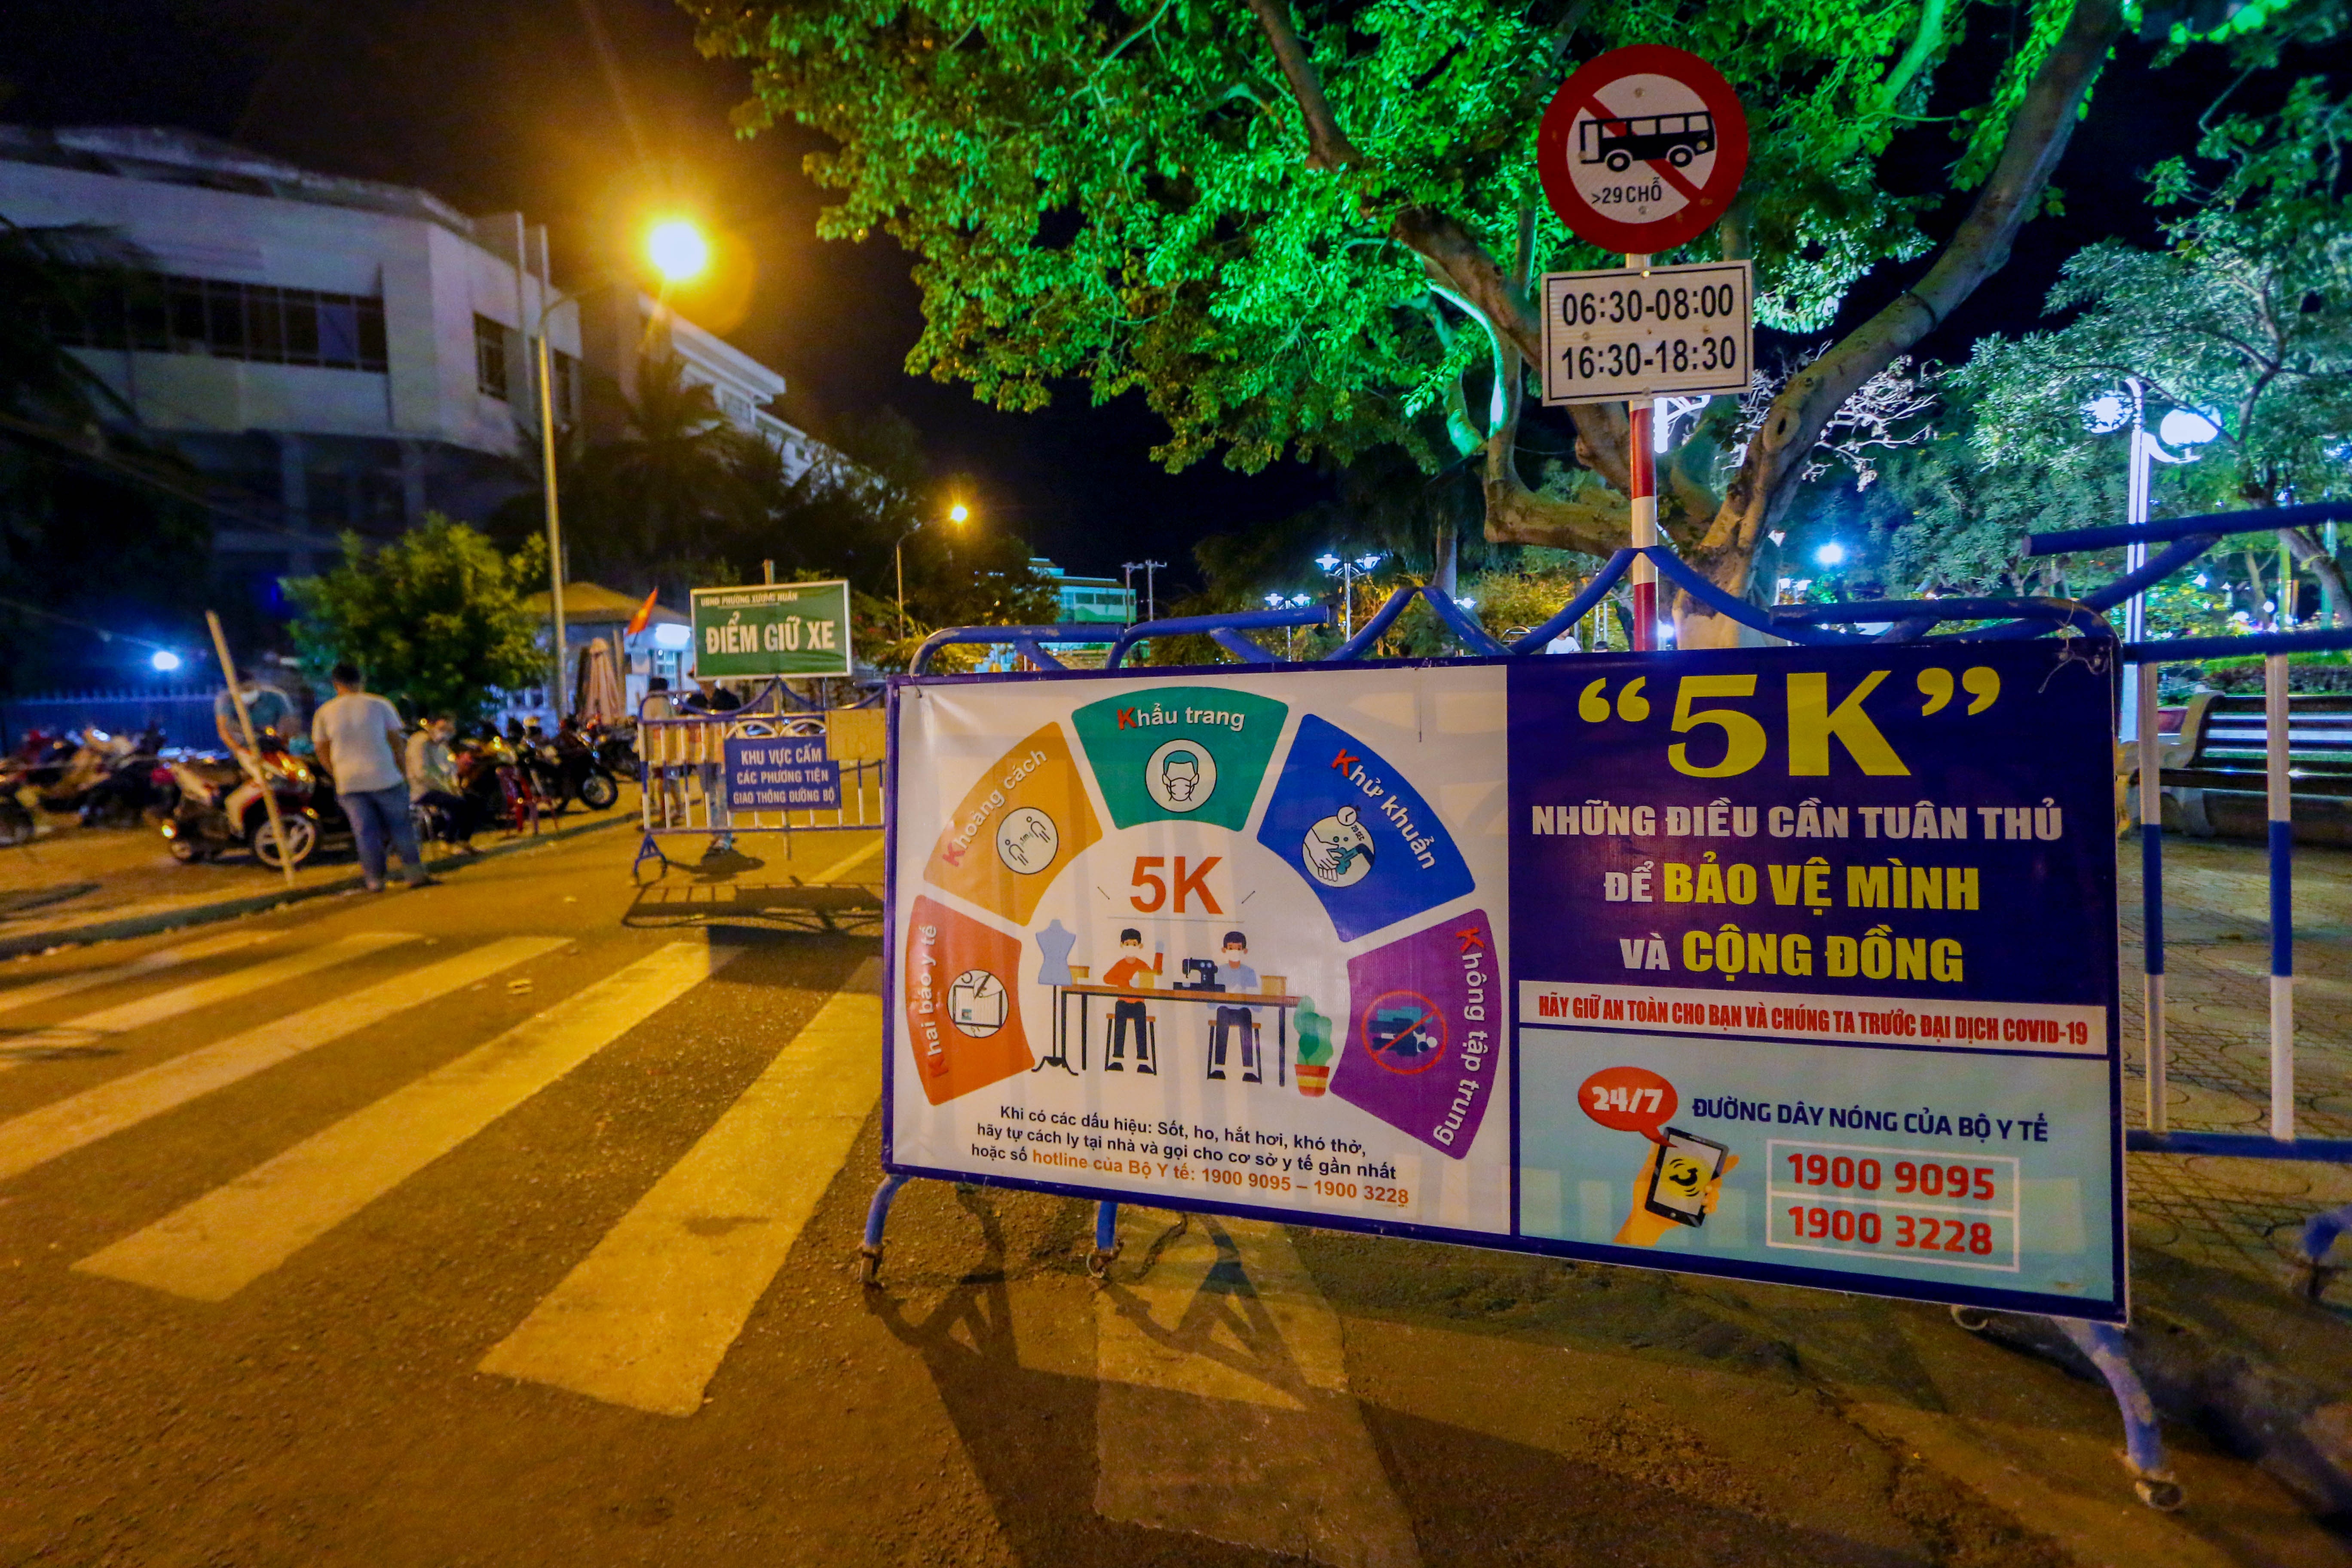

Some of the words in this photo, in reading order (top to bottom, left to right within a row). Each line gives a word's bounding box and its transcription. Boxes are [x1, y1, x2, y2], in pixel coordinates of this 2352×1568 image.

[1626, 177, 1662, 202] CHỖ
[1562, 284, 1733, 326] 06:30-08:00
[1562, 336, 1736, 380] 16:30-18:30
[701, 597, 720, 606] UBND
[706, 610, 758, 654] ĐIỂM
[764, 615, 801, 652] GIỮ
[807, 620, 835, 650] XE
[1117, 703, 1178, 731] Khẩu
[1185, 706, 1245, 732] trang
[737, 770, 757, 784] CÁC
[761, 769, 802, 783] PHƯƠNG
[805, 767, 829, 784] TIỆN
[741, 750, 764, 765] KHU
[769, 747, 792, 768] VỰC
[796, 743, 822, 763] CẤM
[733, 791, 753, 804] GIAO
[756, 788, 786, 803] THÔNG
[823, 786, 835, 804] BỘ
[942, 789, 1005, 867] Khoảng
[1004, 747, 1047, 790] cách
[1330, 748, 1384, 798] Khử
[1381, 795, 1436, 870] khuẩn
[1533, 799, 1656, 837] NHỮNG
[1666, 797, 1757, 837] ĐIỀU
[1768, 797, 1848, 838] CẦN
[1858, 800, 1967, 839] TUÂN
[1977, 798, 2062, 840] THỦ
[1130, 856, 1224, 915] 5K
[1604, 860, 1653, 903] ĐỂ
[1664, 851, 1757, 905] BẢO
[1768, 856, 1831, 915] VỆ
[1847, 858, 1979, 910] MÌNH
[918, 925, 937, 946] tế
[1620, 933, 1670, 970] VÀ
[1682, 924, 1812, 981] CỘNG
[1825, 924, 1963, 982] ĐỒNG
[921, 954, 936, 966] y
[1456, 927, 1488, 1021] Không
[918, 973, 934, 1015] báo
[1539, 992, 1569, 1017] HÃY
[1573, 994, 1601, 1019] GIỮ
[1603, 999, 1623, 1020] AN
[1627, 997, 1668, 1023] TOÀN
[1672, 1002, 1704, 1025] CHO
[1709, 1005, 1742, 1031] BẠN
[1745, 1002, 1767, 1029] VÀ
[1772, 1004, 1829, 1032] CHÚNG
[1833, 1011, 1855, 1033] TA
[1858, 1008, 1916, 1037] TRƯỚC
[1920, 1015, 1950, 1043] ĐẠI
[1955, 1017, 1999, 1044] DỊCH
[2003, 1018, 2088, 1045] COVID-19
[921, 1021, 949, 1077] Khai
[1461, 1031, 1488, 1072] tập
[1433, 1080, 1479, 1146] trung
[1591, 1086, 1663, 1114] 24/7
[1692, 1098, 1771, 1123] ĐƯỜNG
[1777, 1101, 1824, 1127] DÂY
[1829, 1104, 1898, 1132] NÓNG
[1904, 1106, 1952, 1135] CỦA
[1958, 1112, 1991, 1144] BỘ
[1997, 1119, 2014, 1139] Y
[2018, 1113, 2048, 1143] TẾ
[978, 1123, 1002, 1140] hãy
[1007, 1127, 1023, 1142] tự
[1028, 1130, 1061, 1144] cách
[1067, 1133, 1079, 1149] ly
[1084, 1135, 1102, 1152] tại
[1107, 1138, 1135, 1152] nhà
[1140, 1141, 1158, 1155] và
[1164, 1143, 1187, 1161] gọi
[1193, 1147, 1223, 1161] cho
[1228, 1152, 1250, 1164] cơ
[1256, 1153, 1277, 1167] sở
[1283, 1158, 1292, 1171] y
[1298, 1155, 1313, 1170] tế
[1319, 1157, 1350, 1176] gần
[1357, 1162, 1396, 1180] nhất
[1001, 1106, 1023, 1121] Khi
[1029, 1110, 1045, 1122] có
[1051, 1112, 1076, 1125] các
[1081, 1113, 1109, 1129] dấu
[1114, 1118, 1152, 1137] hiệu:
[1158, 1120, 1188, 1139] Sốt,
[1194, 1126, 1219, 1142] ho,
[1225, 1127, 1250, 1144] hắt
[1256, 1131, 1287, 1149] hơi,
[1294, 1135, 1325, 1151] khó
[1331, 1139, 1366, 1157] thở,
[972, 1144, 1005, 1161] hoặc
[1011, 1146, 1027, 1161] số
[1032, 1149, 1087, 1169] hotline
[1093, 1157, 1123, 1173] của
[1129, 1160, 1152, 1179] Bộ
[1157, 1163, 1168, 1177] Y
[1173, 1162, 1195, 1180] tế:
[1202, 1168, 1242, 1186] 1900
[1249, 1173, 1290, 1191] 9095
[1314, 1179, 1357, 1198] 1900
[1364, 1185, 1409, 1204] 3228
[1787, 1153, 1881, 1191] 1900
[1894, 1160, 1995, 1201] 9095
[1788, 1205, 1881, 1244] 1900
[1895, 1215, 1993, 1256] 3228
